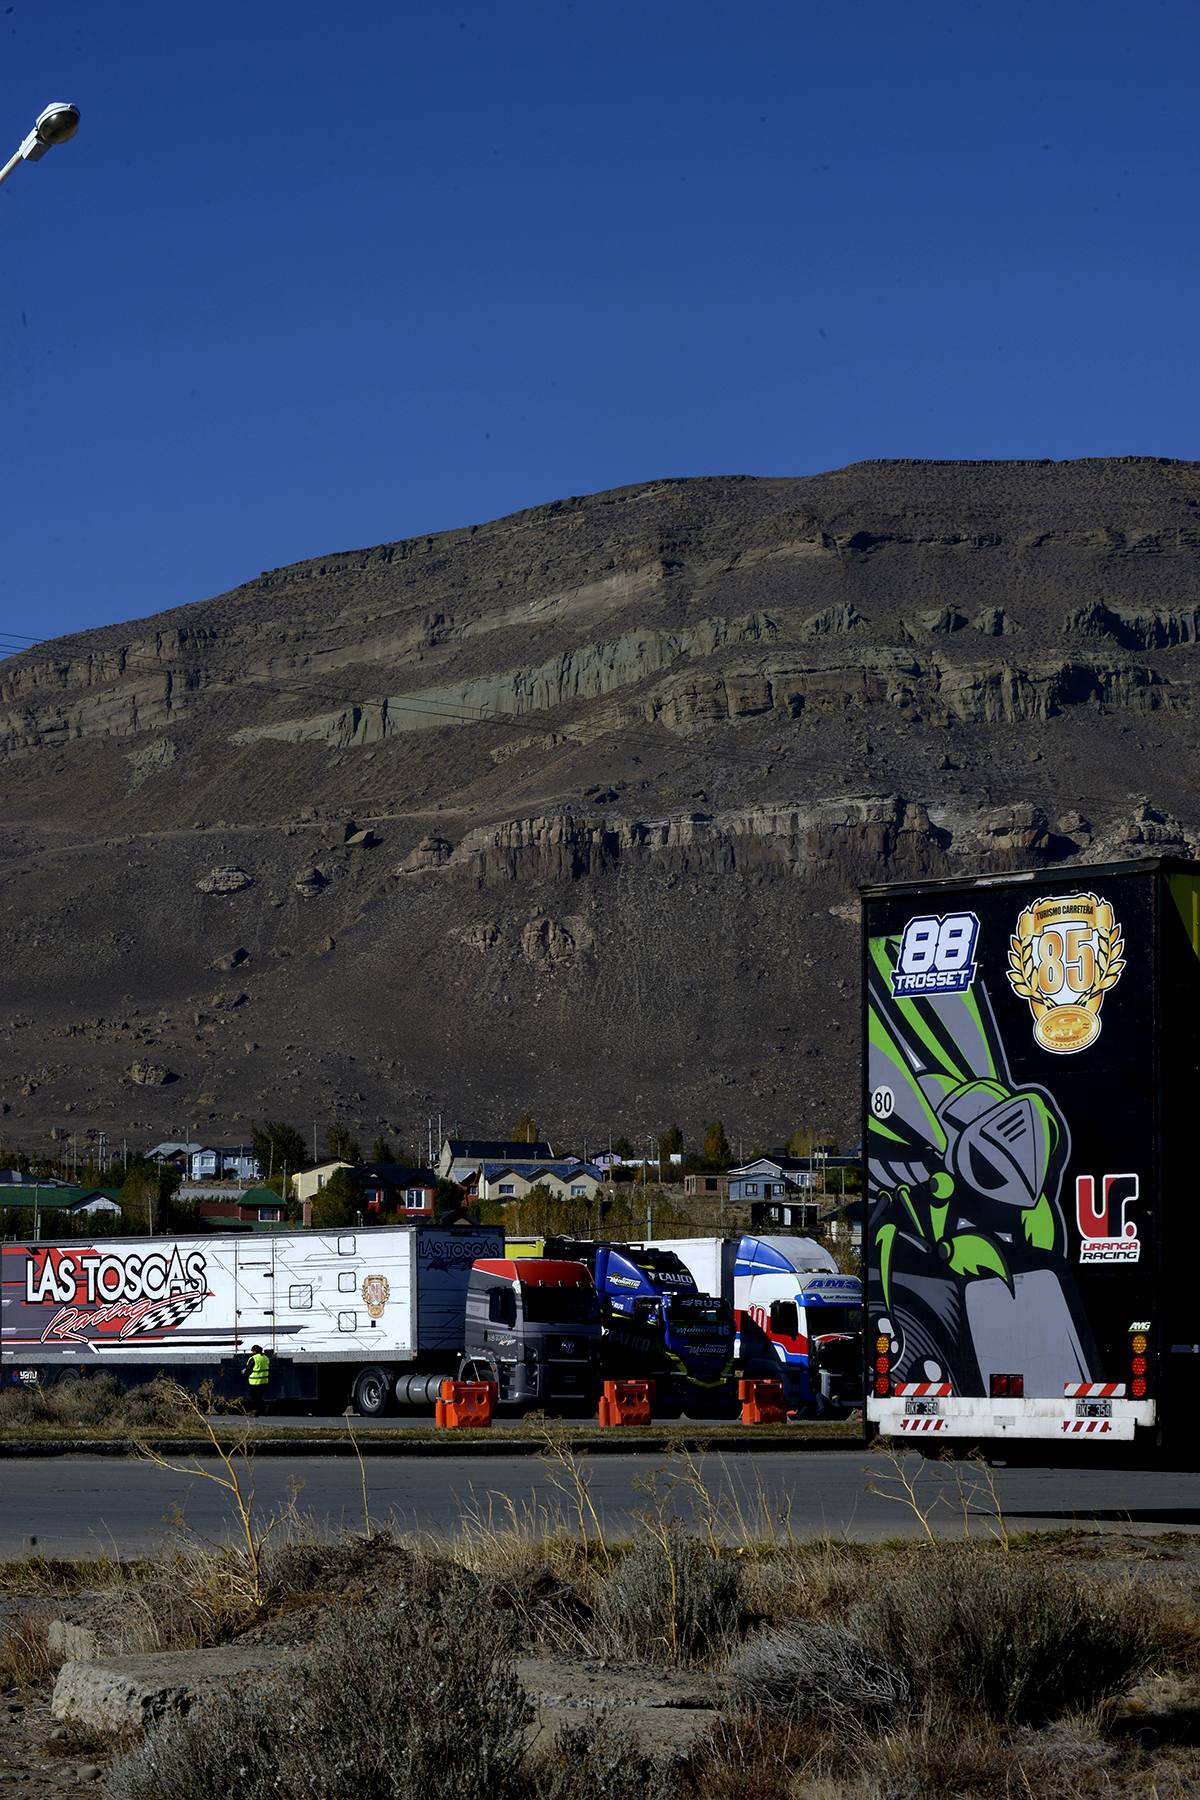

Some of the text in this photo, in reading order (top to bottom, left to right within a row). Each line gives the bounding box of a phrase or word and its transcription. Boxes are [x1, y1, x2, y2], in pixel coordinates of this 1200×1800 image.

[1036, 904, 1094, 921] TURISMO CARRETERA
[901, 916, 974, 974] 88
[1038, 928, 1095, 995] 85
[895, 970, 970, 989] TROSSET
[874, 1092, 892, 1113] 80
[419, 1237, 499, 1259] LAS TOSCAS
[1083, 1242, 1138, 1251] URANGA
[1083, 1251, 1137, 1260] RACING
[26, 1245, 207, 1303] LAS TOSCAS
[658, 1272, 693, 1284] CALICO
[694, 1300, 721, 1308] RUS
[40, 1296, 190, 1343] Racing
[1128, 1321, 1151, 1331] AMG
